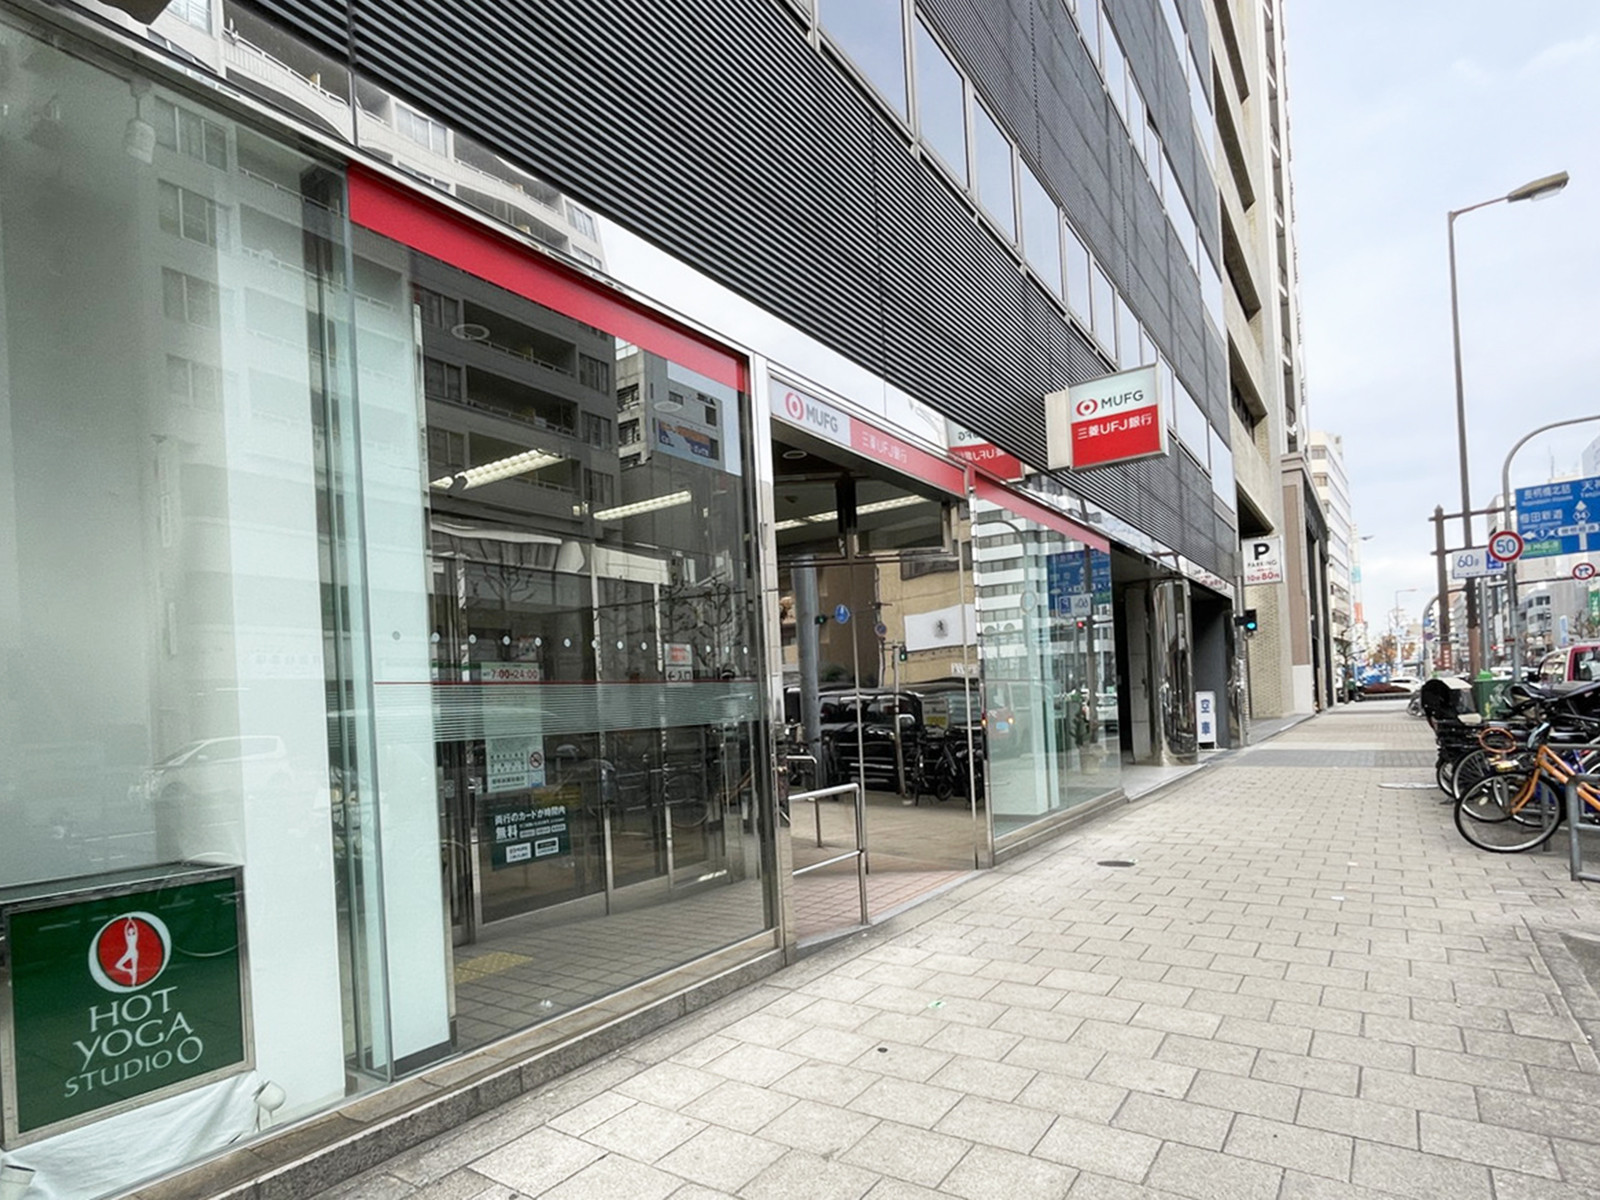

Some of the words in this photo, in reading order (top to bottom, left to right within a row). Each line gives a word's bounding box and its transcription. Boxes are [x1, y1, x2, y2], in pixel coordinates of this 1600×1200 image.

[1101, 390, 1144, 409] MUFG
[806, 403, 838, 433] MUFG
[1078, 413, 1152, 440] 三菱UFJ銀行
[1253, 543, 1270, 560] P
[1496, 539, 1516, 554] 50
[90, 986, 178, 1033] HOT
[73, 1011, 195, 1072] YOGA
[64, 1049, 173, 1098] STUDIO
